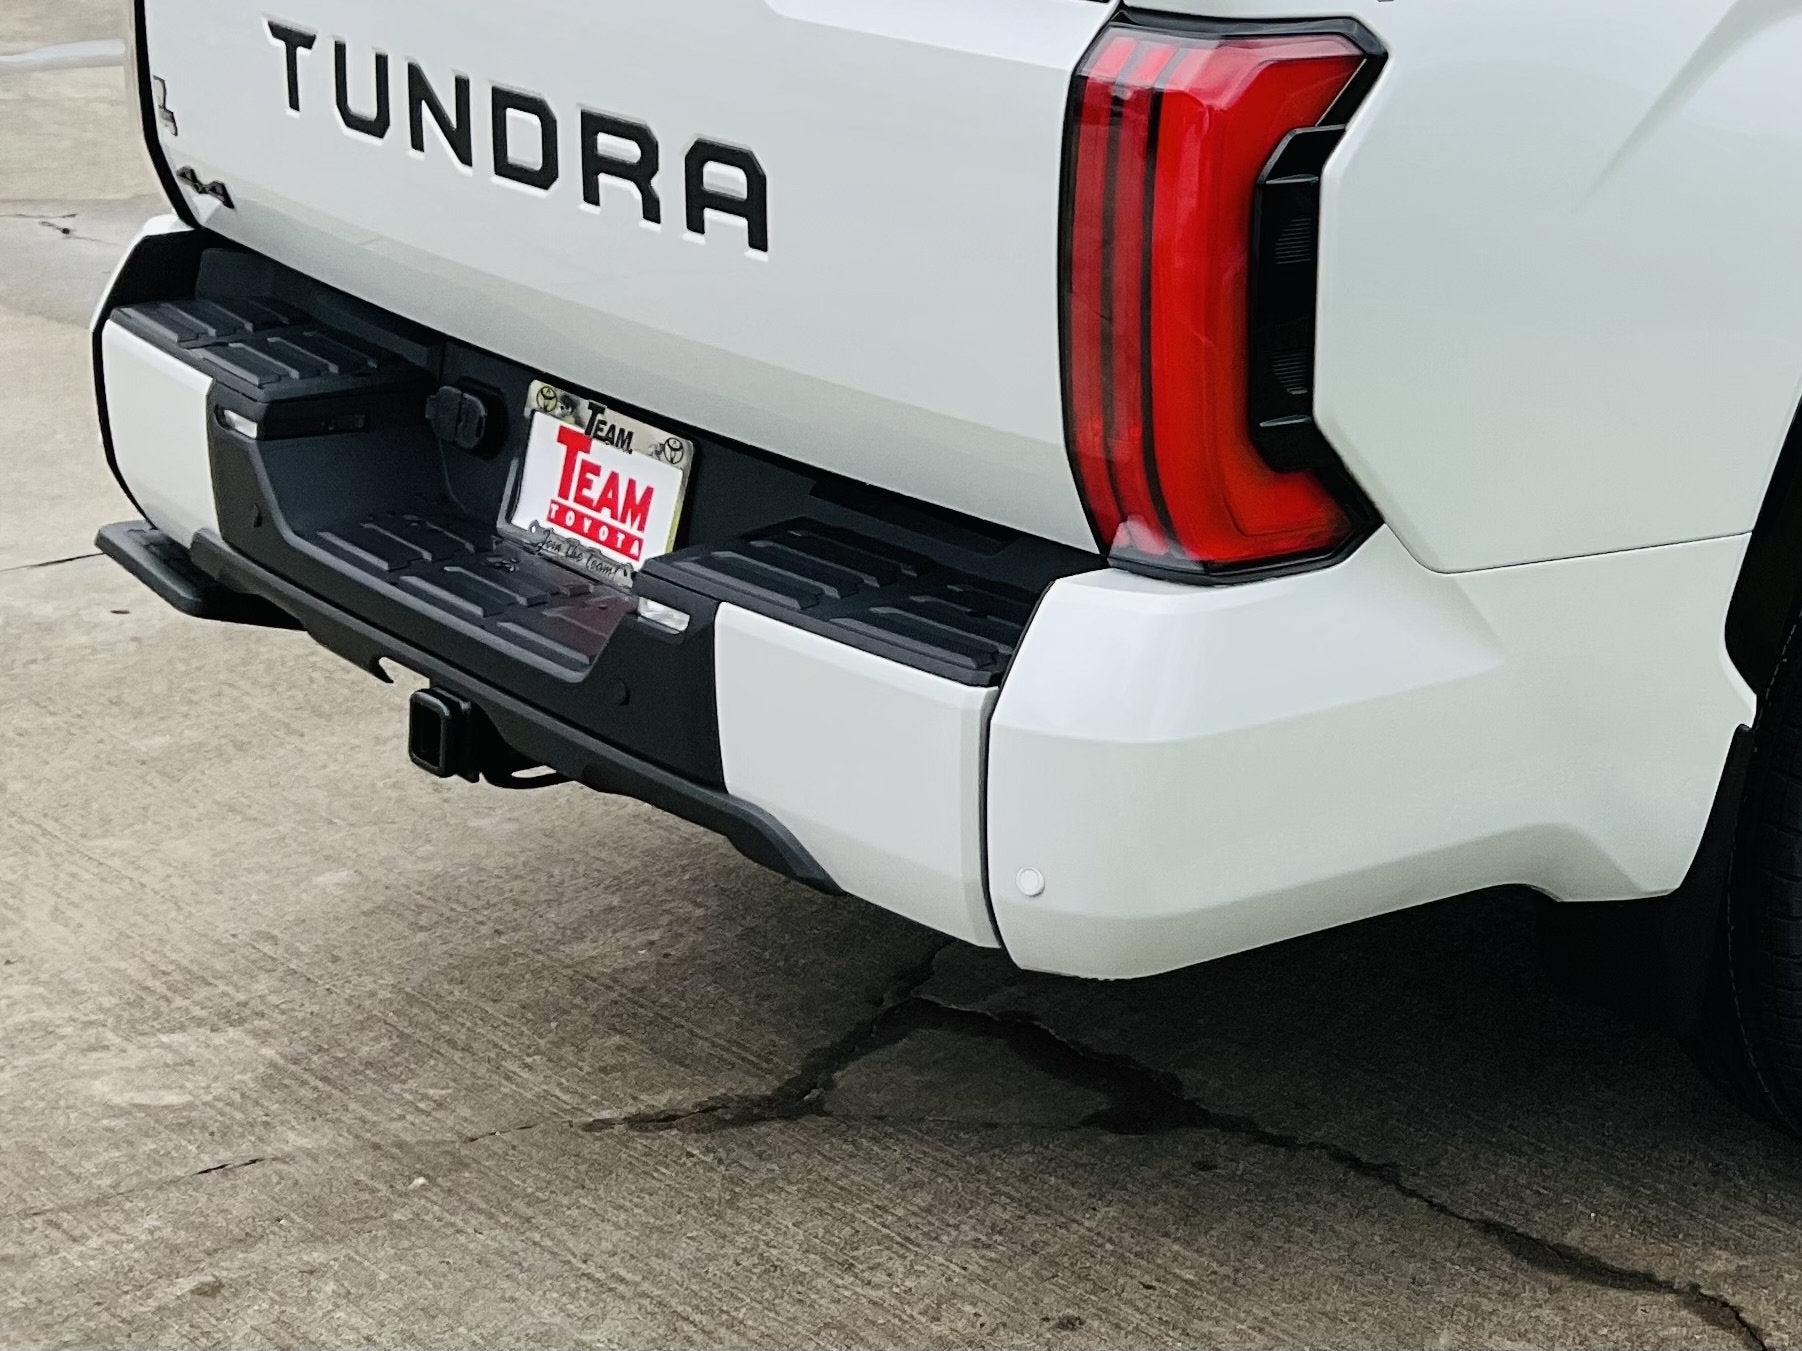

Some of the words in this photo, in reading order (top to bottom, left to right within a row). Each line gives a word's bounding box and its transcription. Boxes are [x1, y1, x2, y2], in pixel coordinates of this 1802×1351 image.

[265, 17, 769, 257] TUNDRA
[550, 503, 641, 557] TOYOTA
[556, 424, 655, 533] TEAM
